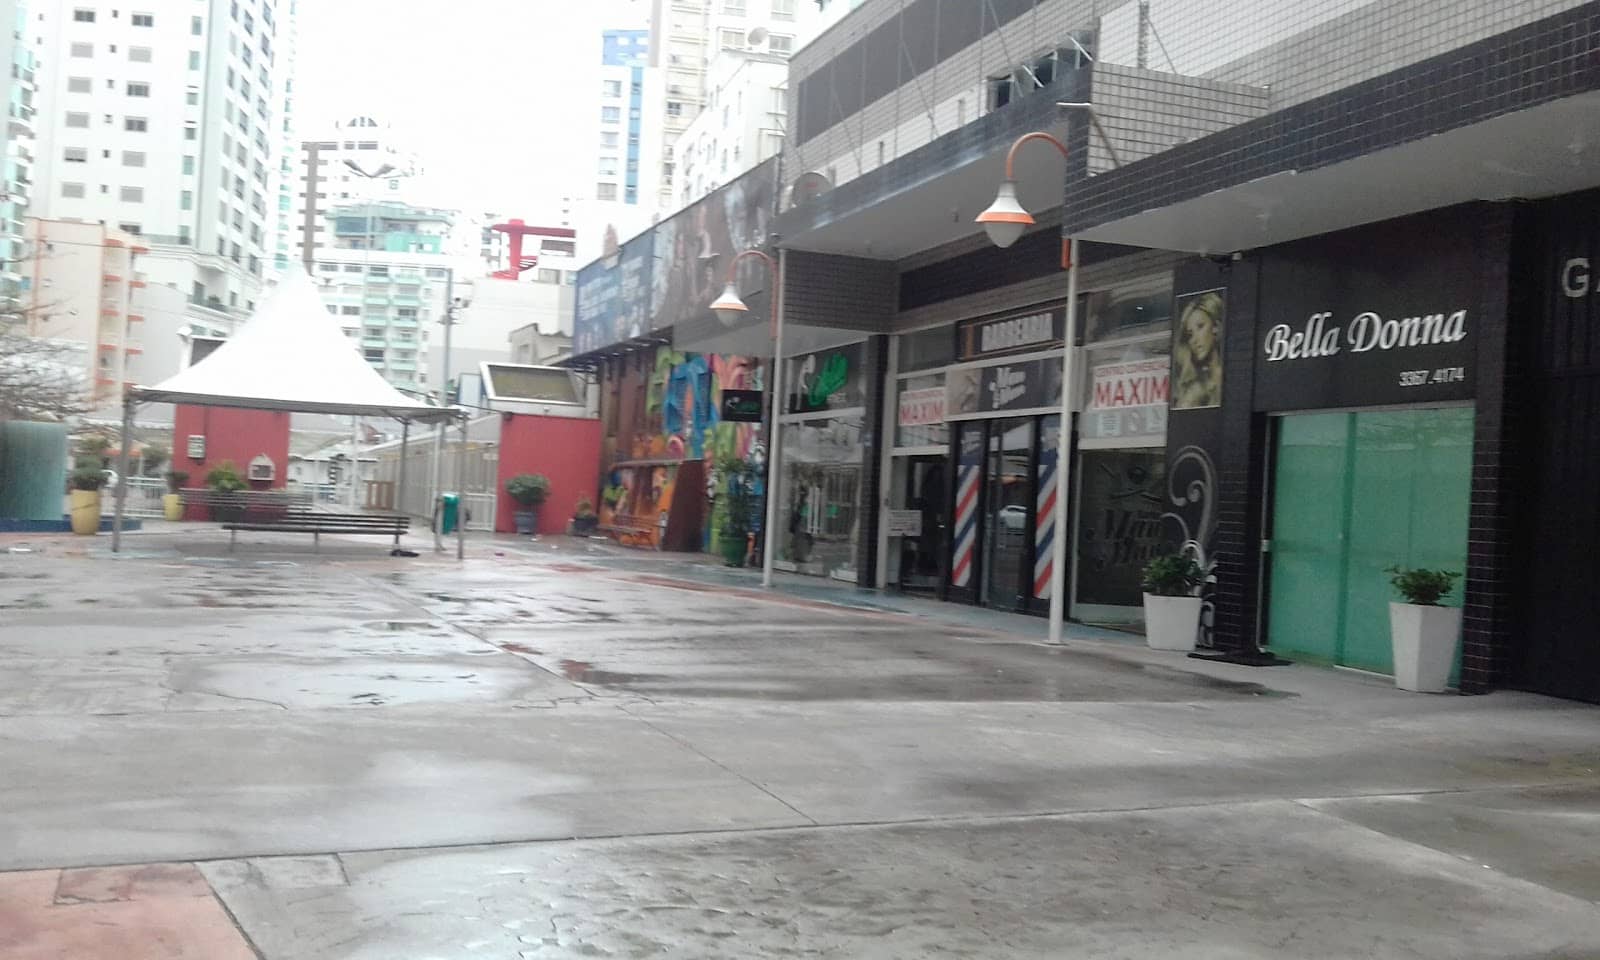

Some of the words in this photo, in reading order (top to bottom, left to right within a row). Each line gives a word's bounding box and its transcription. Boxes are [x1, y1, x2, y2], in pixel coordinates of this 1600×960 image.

[1561, 257, 1600, 298] G
[1264, 311, 1340, 362] Bella
[1347, 308, 1467, 353] Donna
